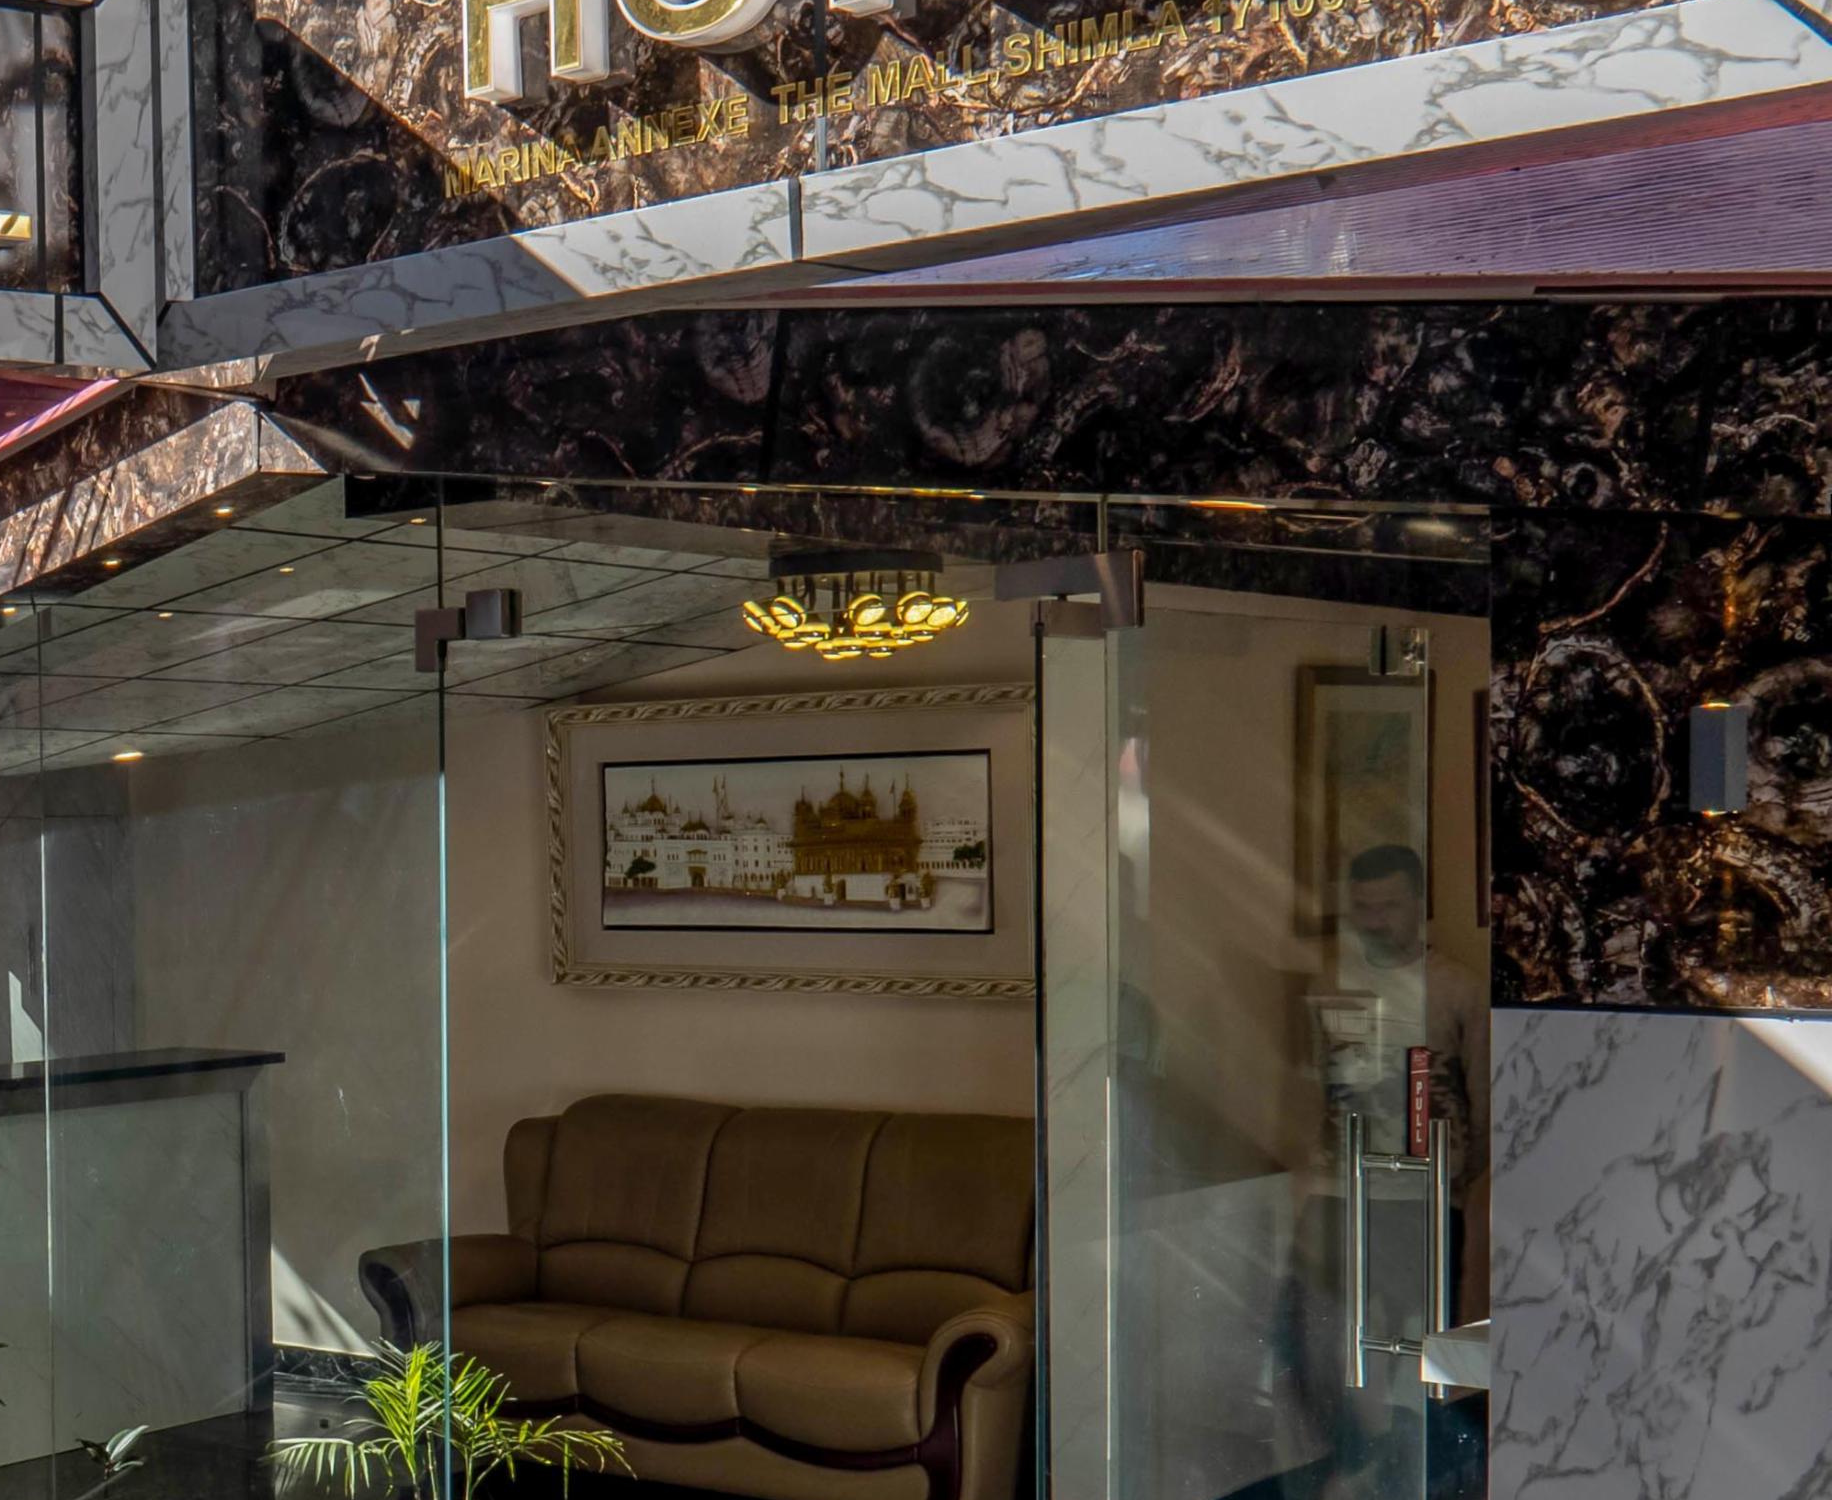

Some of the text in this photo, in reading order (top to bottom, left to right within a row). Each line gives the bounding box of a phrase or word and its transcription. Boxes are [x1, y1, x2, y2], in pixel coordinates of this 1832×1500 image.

[443, 133, 584, 199] MARINA
[591, 92, 750, 164] ANNEXE
[770, 70, 855, 126] THE
[1415, 1080, 1424, 1144] PULL
